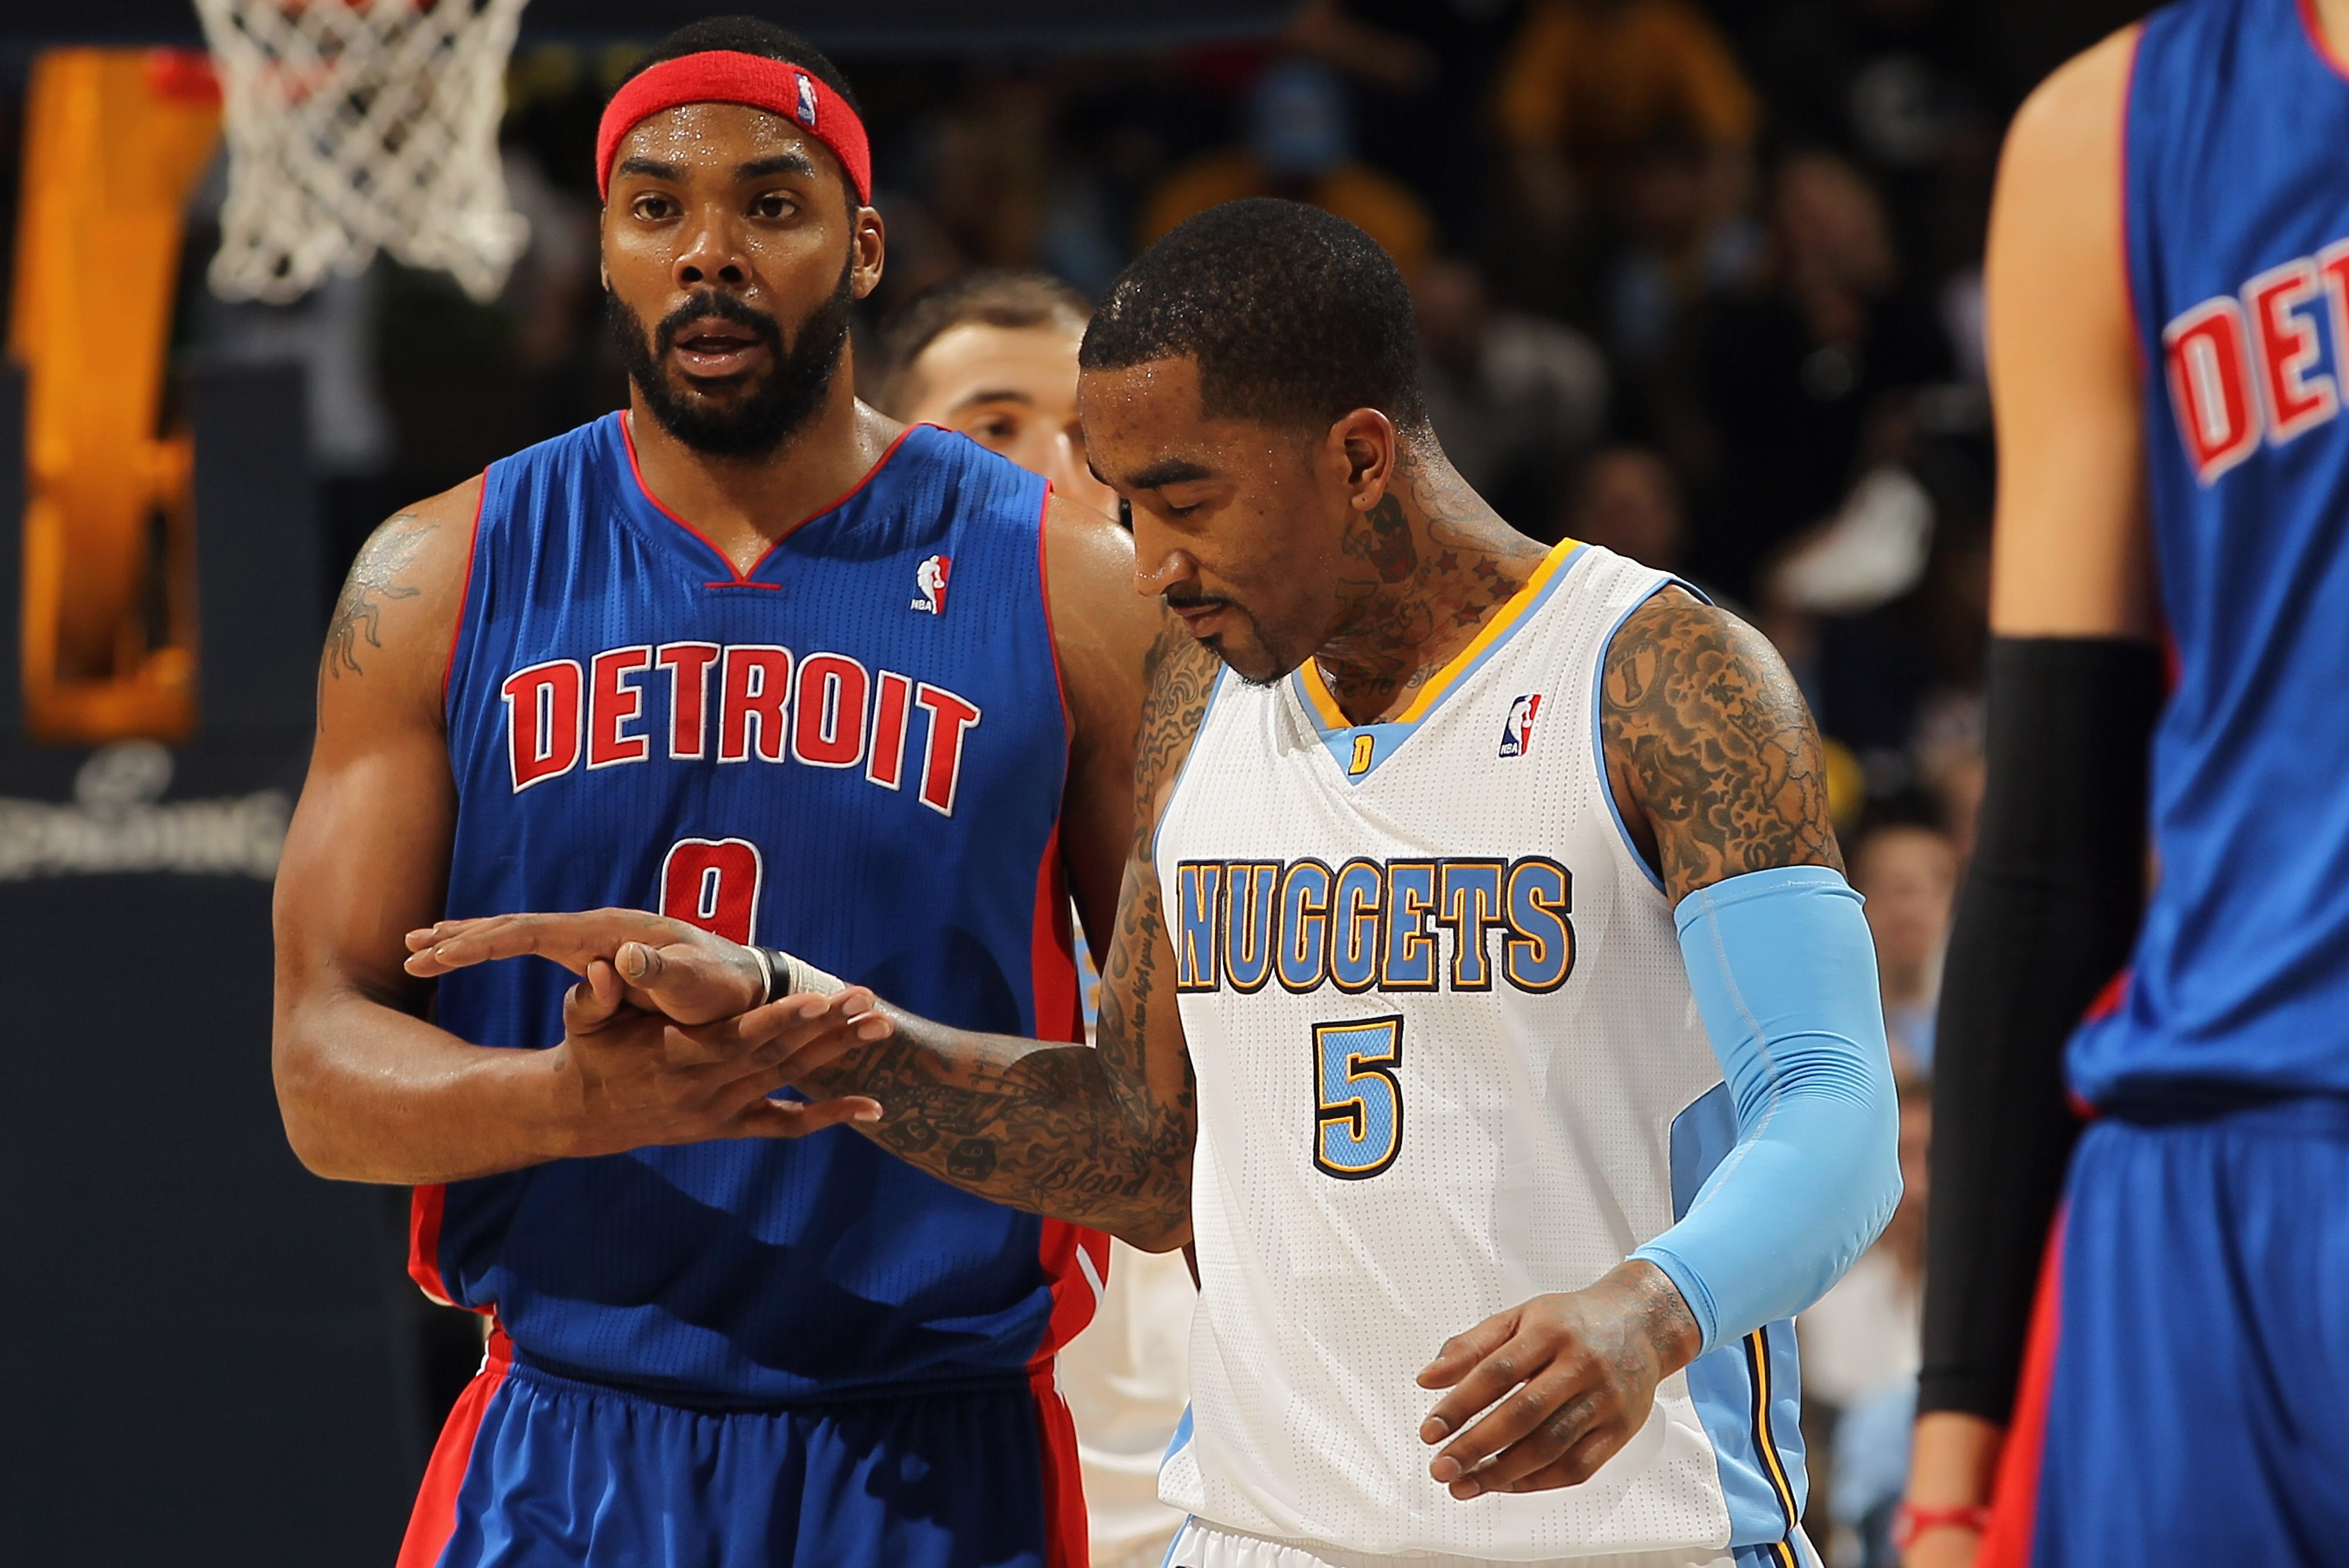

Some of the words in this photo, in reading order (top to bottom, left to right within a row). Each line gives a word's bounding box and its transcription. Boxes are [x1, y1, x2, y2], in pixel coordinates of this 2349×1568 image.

[910, 599, 932, 612] NBA
[500, 641, 982, 817] DETROIT
[1348, 733, 1375, 776] D
[1500, 742, 1518, 755] NBA
[1176, 856, 1576, 994] NUGGETS
[1312, 1014, 1404, 1180] 5
